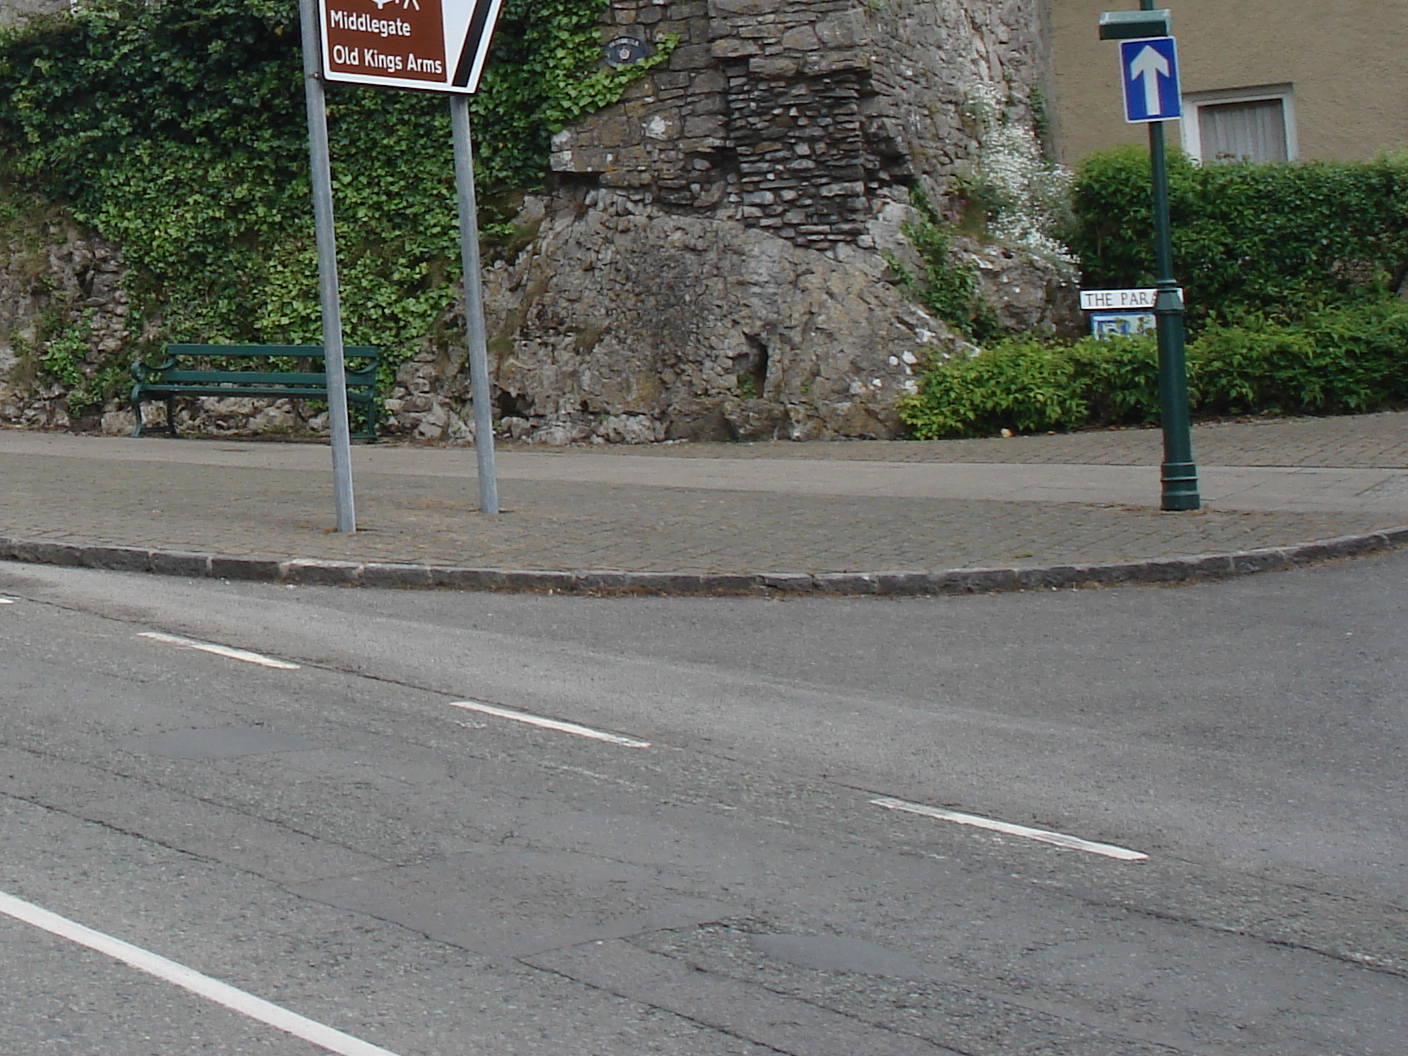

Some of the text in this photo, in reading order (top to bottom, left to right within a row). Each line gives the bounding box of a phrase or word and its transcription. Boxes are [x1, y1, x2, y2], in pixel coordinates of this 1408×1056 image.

[330, 10, 411, 37] Middlegate
[333, 44, 442, 74] Old Kings Arms
[1085, 291, 1158, 306] THE PARA
